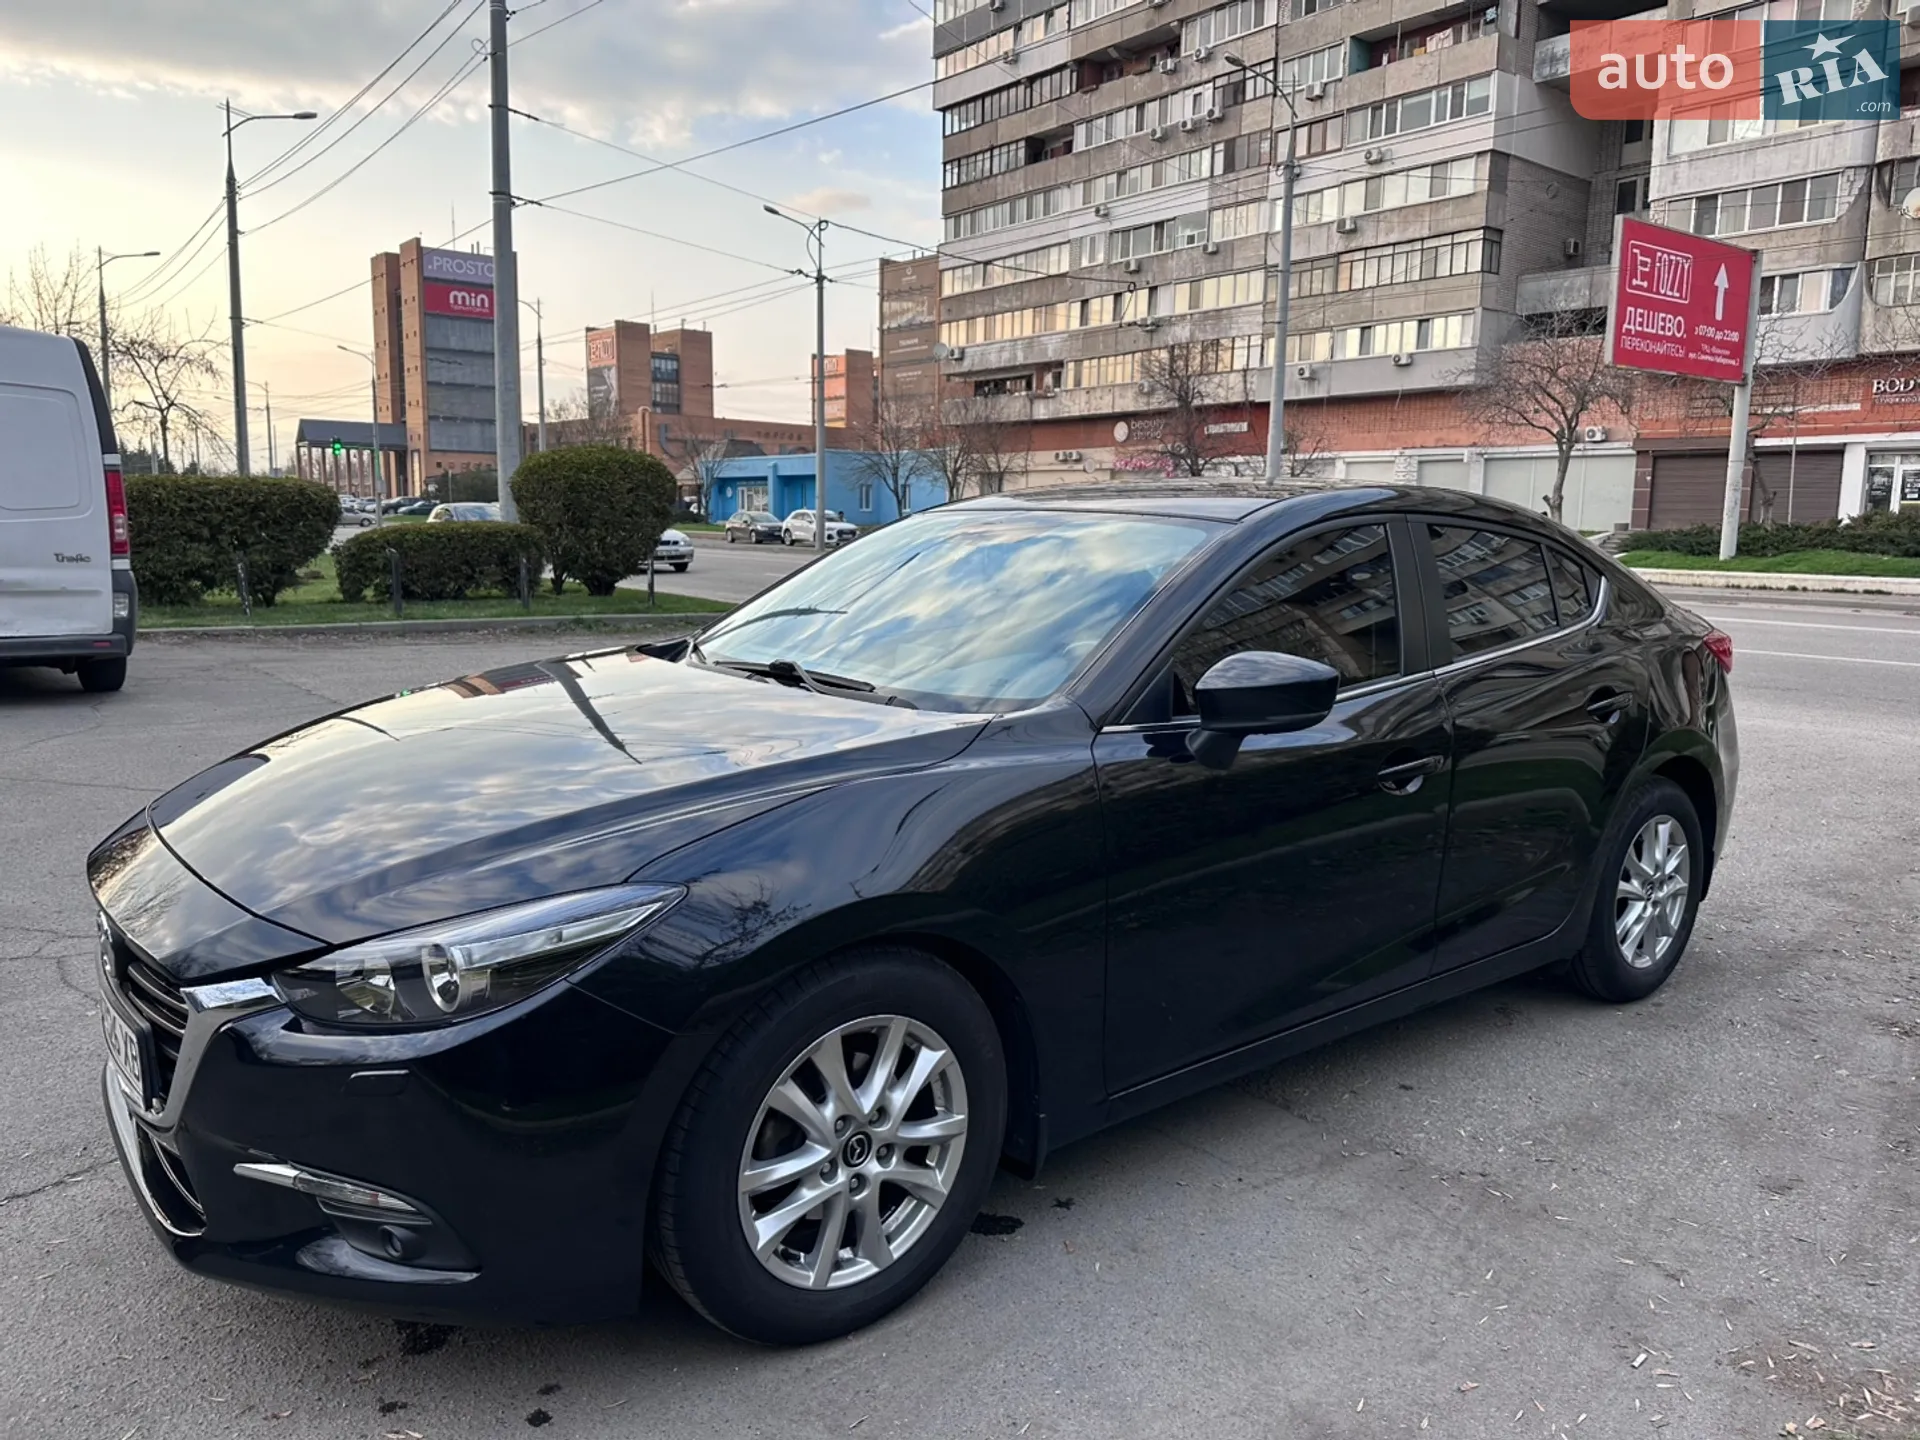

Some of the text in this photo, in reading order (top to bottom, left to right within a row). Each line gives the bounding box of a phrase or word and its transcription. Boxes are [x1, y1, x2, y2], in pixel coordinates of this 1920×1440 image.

[1652, 251, 1693, 299] FOZZY
[449, 290, 489, 308] min
[1622, 306, 1687, 339] ДЕШЕВО.
[53, 552, 92, 564] Trafic
